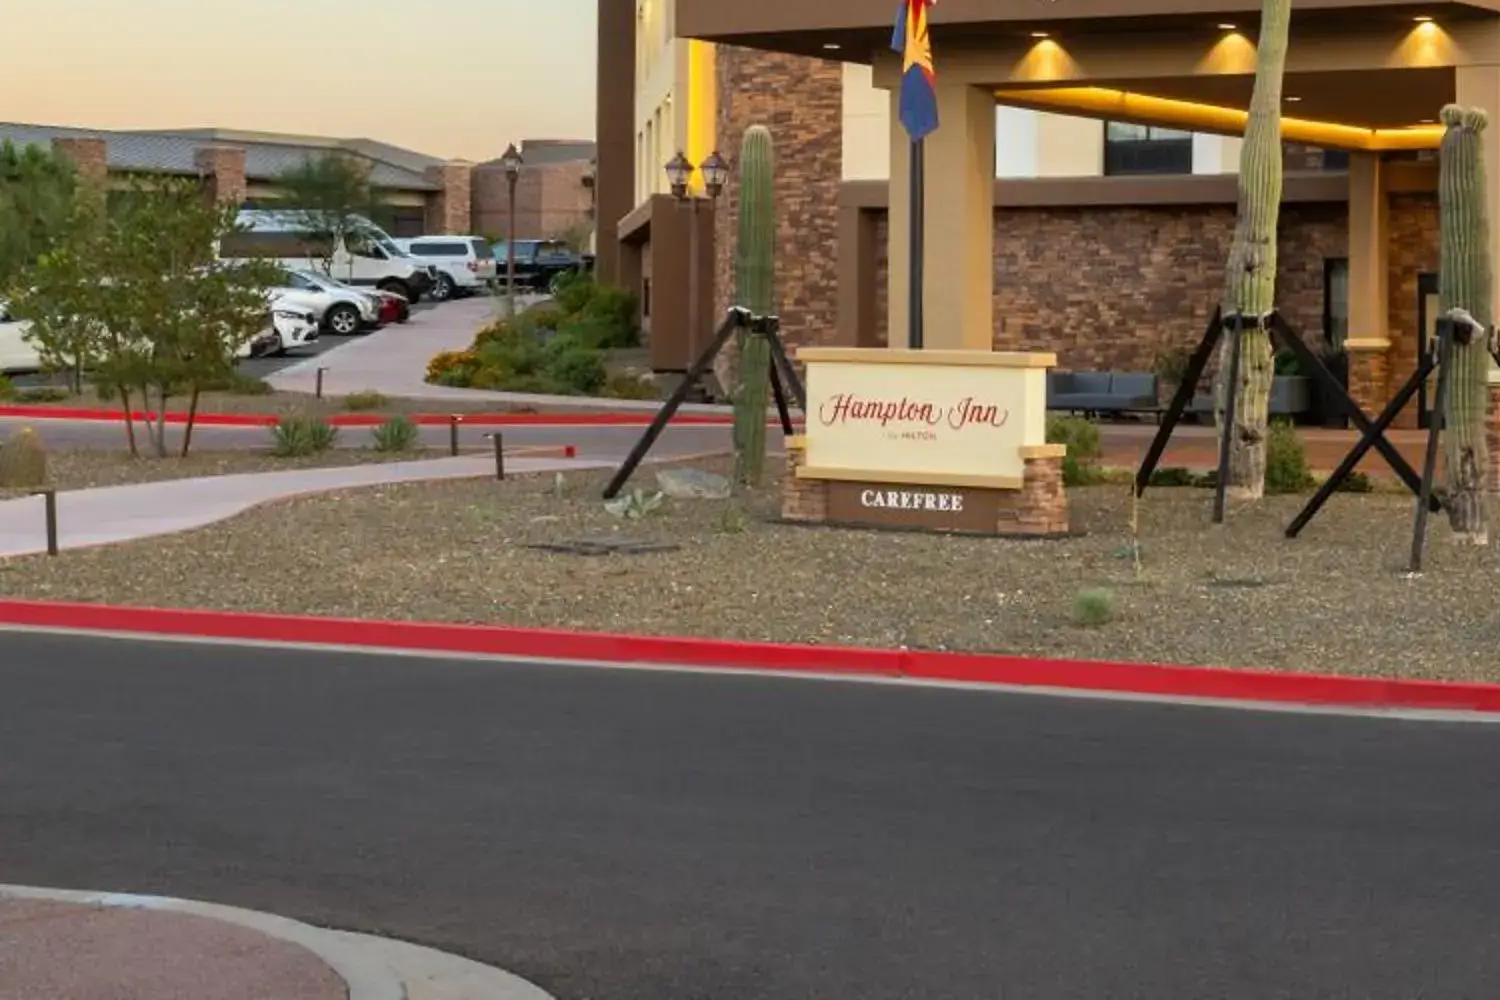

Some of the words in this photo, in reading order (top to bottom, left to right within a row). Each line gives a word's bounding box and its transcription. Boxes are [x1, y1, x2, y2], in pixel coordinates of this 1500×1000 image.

[819, 393, 942, 427] Hampton
[948, 397, 1008, 430] Inn
[861, 489, 963, 512] CAREFREE
